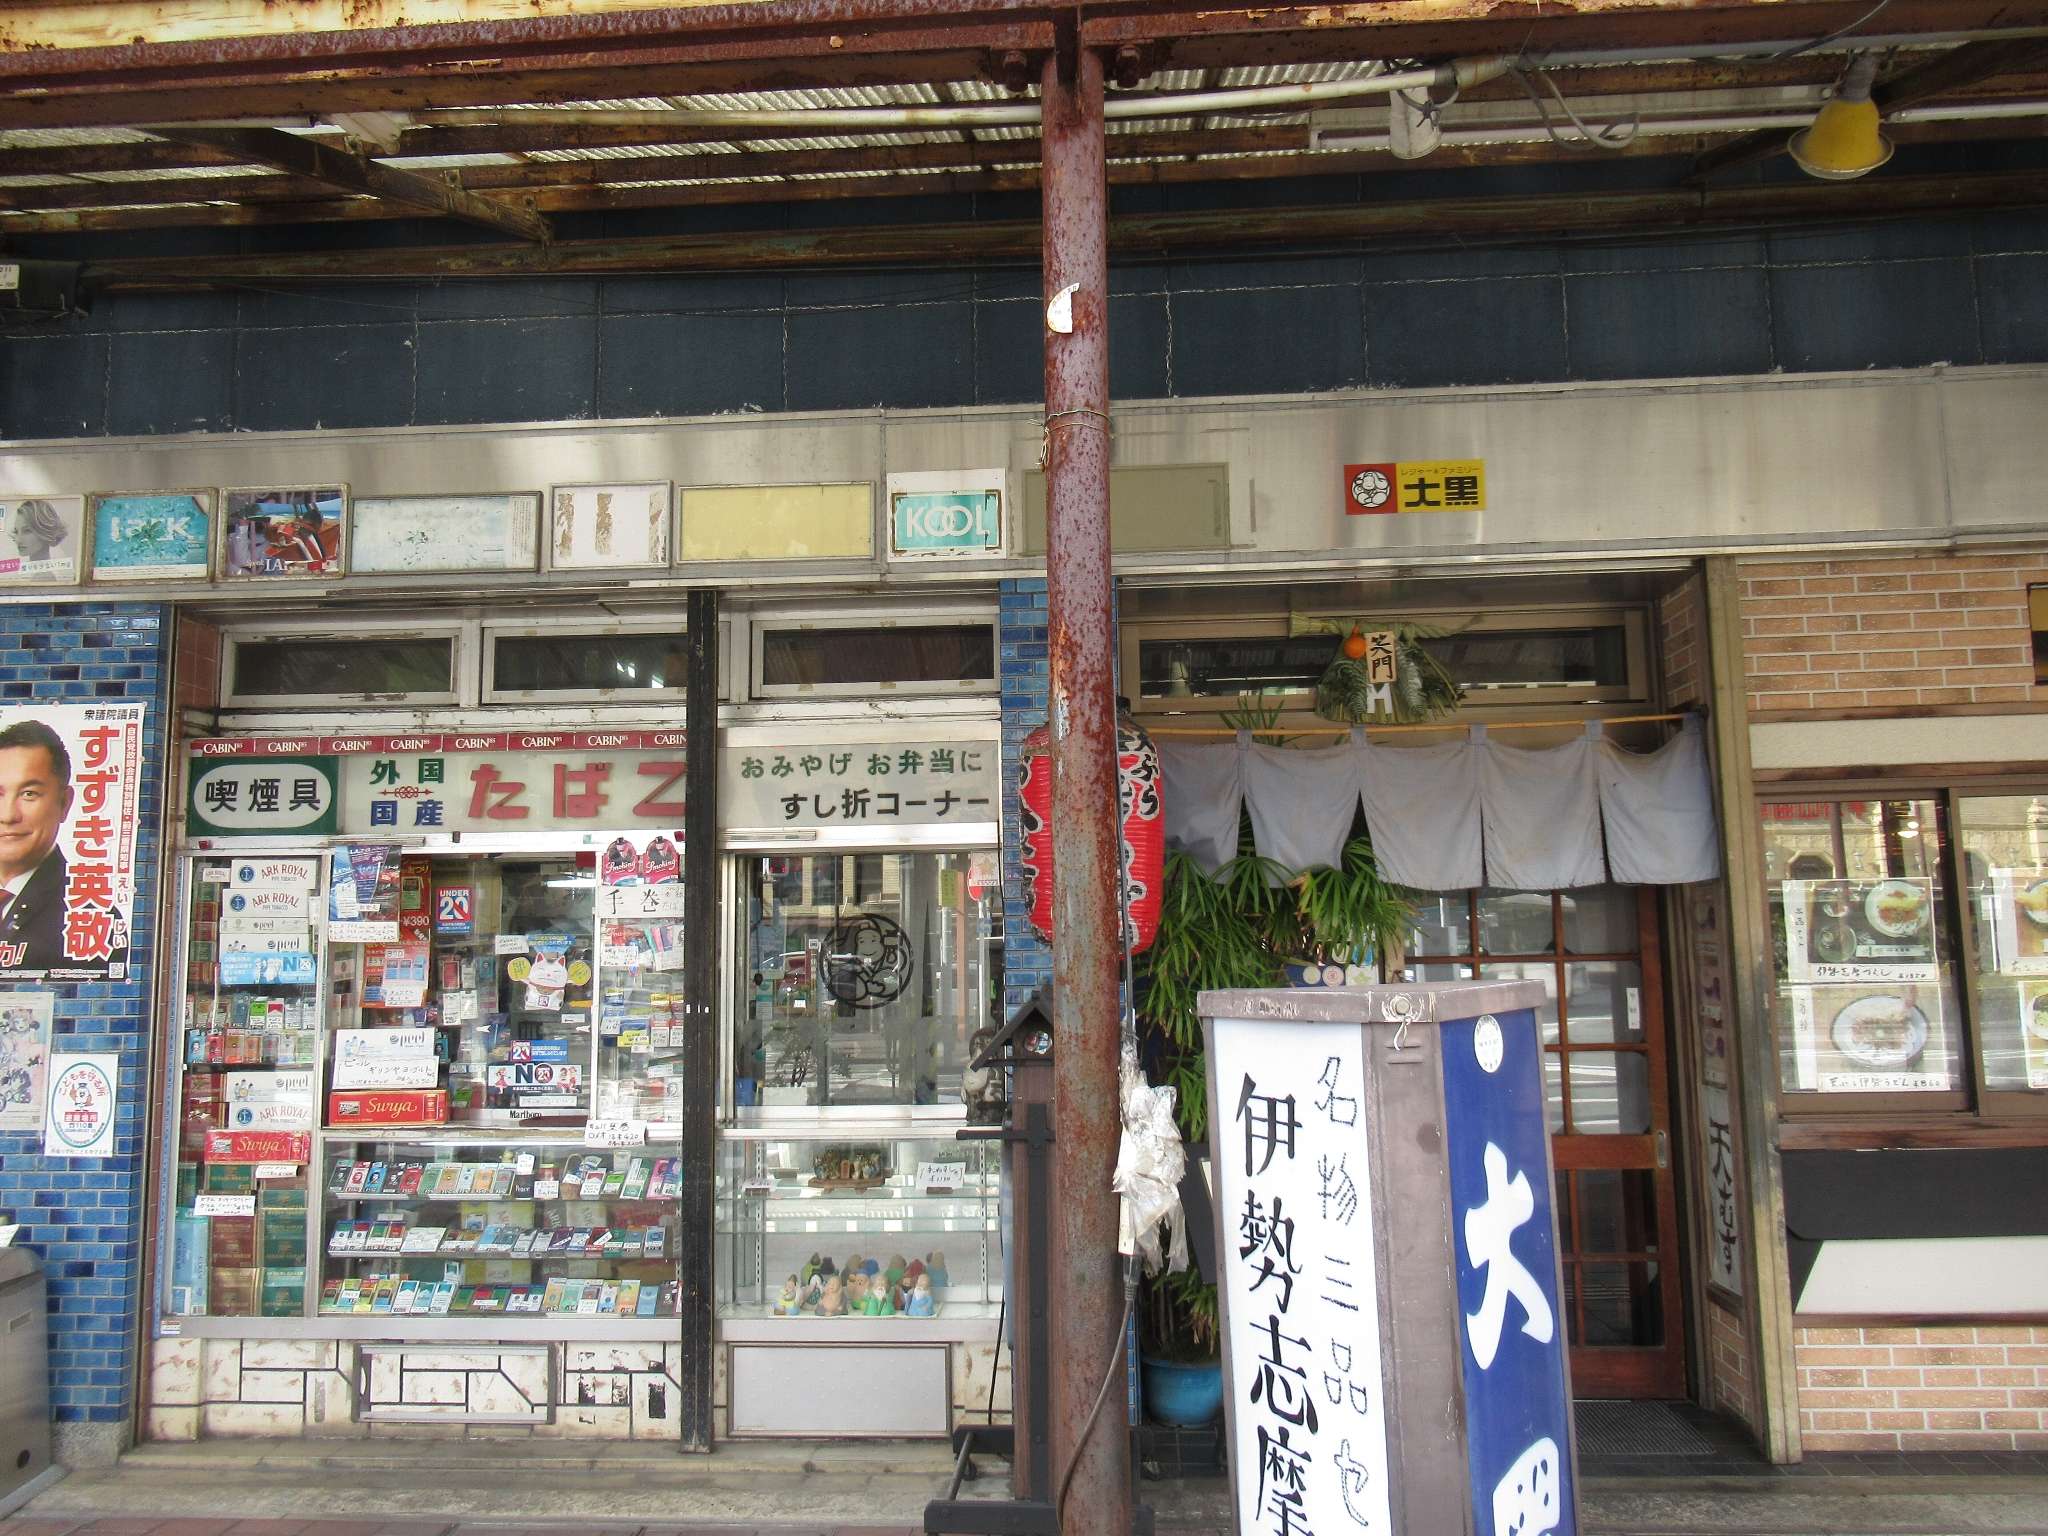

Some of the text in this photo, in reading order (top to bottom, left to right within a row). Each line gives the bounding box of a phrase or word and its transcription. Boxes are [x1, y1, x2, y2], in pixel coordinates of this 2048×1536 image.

[905, 504, 991, 538] KOOL
[1369, 633, 1394, 680] 笑門
[84, 708, 139, 721] 衆議院議員
[369, 758, 445, 785] 外国
[741, 749, 982, 778] おみやげ お弁当に
[205, 778, 321, 813] 喫煙具
[468, 762, 687, 819] たばこ
[370, 799, 444, 827] 国産
[781, 788, 990, 820] すし折コーナー
[67, 725, 120, 958] すずき英敬
[261, 864, 308, 880] ARK ROYAL
[605, 861, 636, 874] Smoking
[645, 859, 676, 874] Smoking
[252, 892, 300, 908] ARK ROYAL
[403, 915, 429, 926] ¥390
[258, 1106, 279, 1120] ARK
[367, 1097, 418, 1118] Surya
[238, 1137, 286, 1158] Surya
